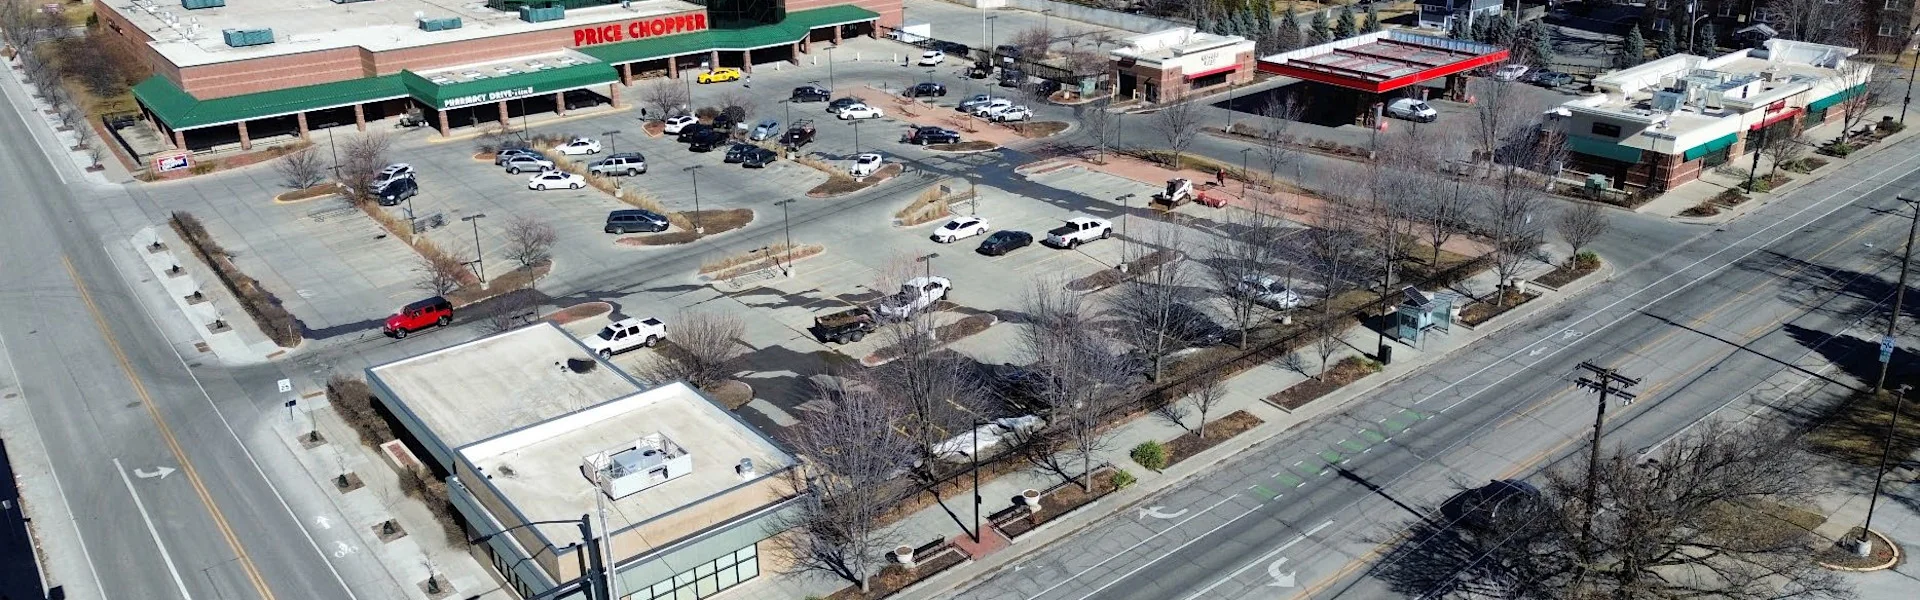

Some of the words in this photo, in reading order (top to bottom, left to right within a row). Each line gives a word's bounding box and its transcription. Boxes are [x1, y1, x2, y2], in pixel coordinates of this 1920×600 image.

[573, 24, 623, 47] PRICE
[628, 13, 707, 39] CHOPPER
[444, 93, 487, 108] PHARMACY
